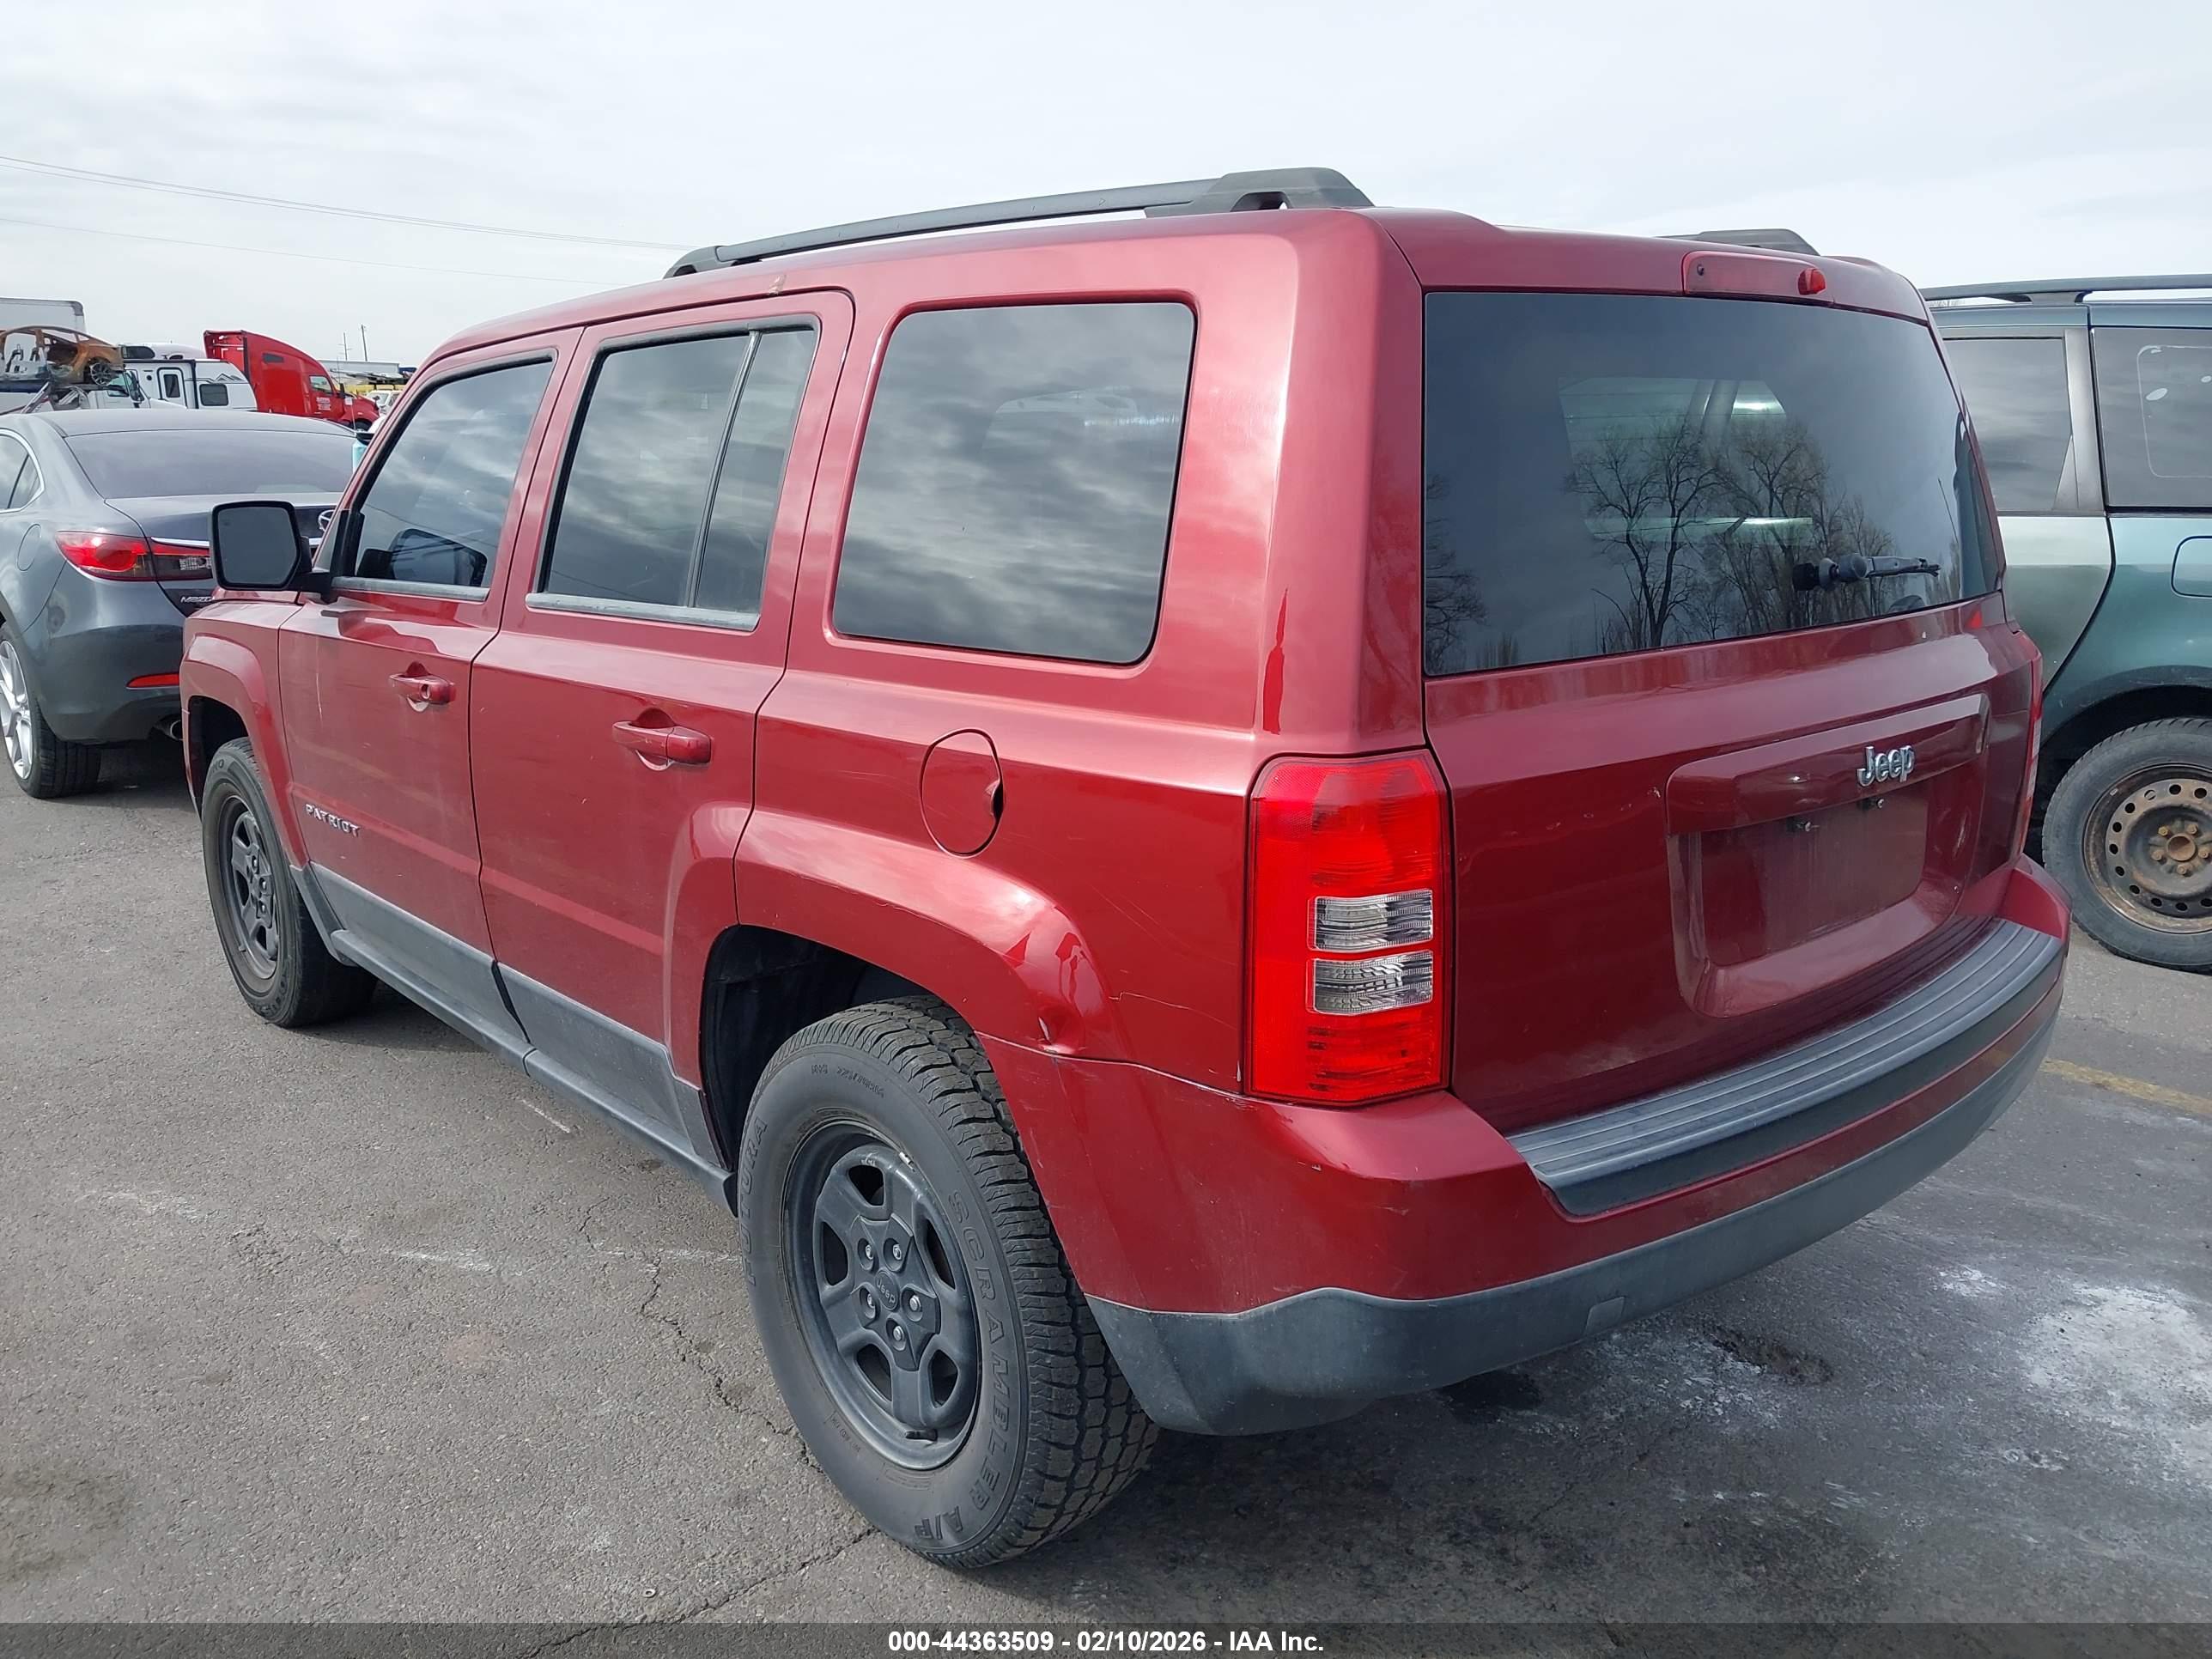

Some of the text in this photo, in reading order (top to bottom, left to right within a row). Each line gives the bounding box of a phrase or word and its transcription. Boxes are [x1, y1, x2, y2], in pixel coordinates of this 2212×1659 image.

[1856, 745, 1915, 787] Jeep
[305, 804, 360, 837] PATRIOT
[741, 1117, 768, 1287] FUTURA
[877, 1276, 896, 1304] Jeep
[948, 1190, 1010, 1510] SCRAMBLER
